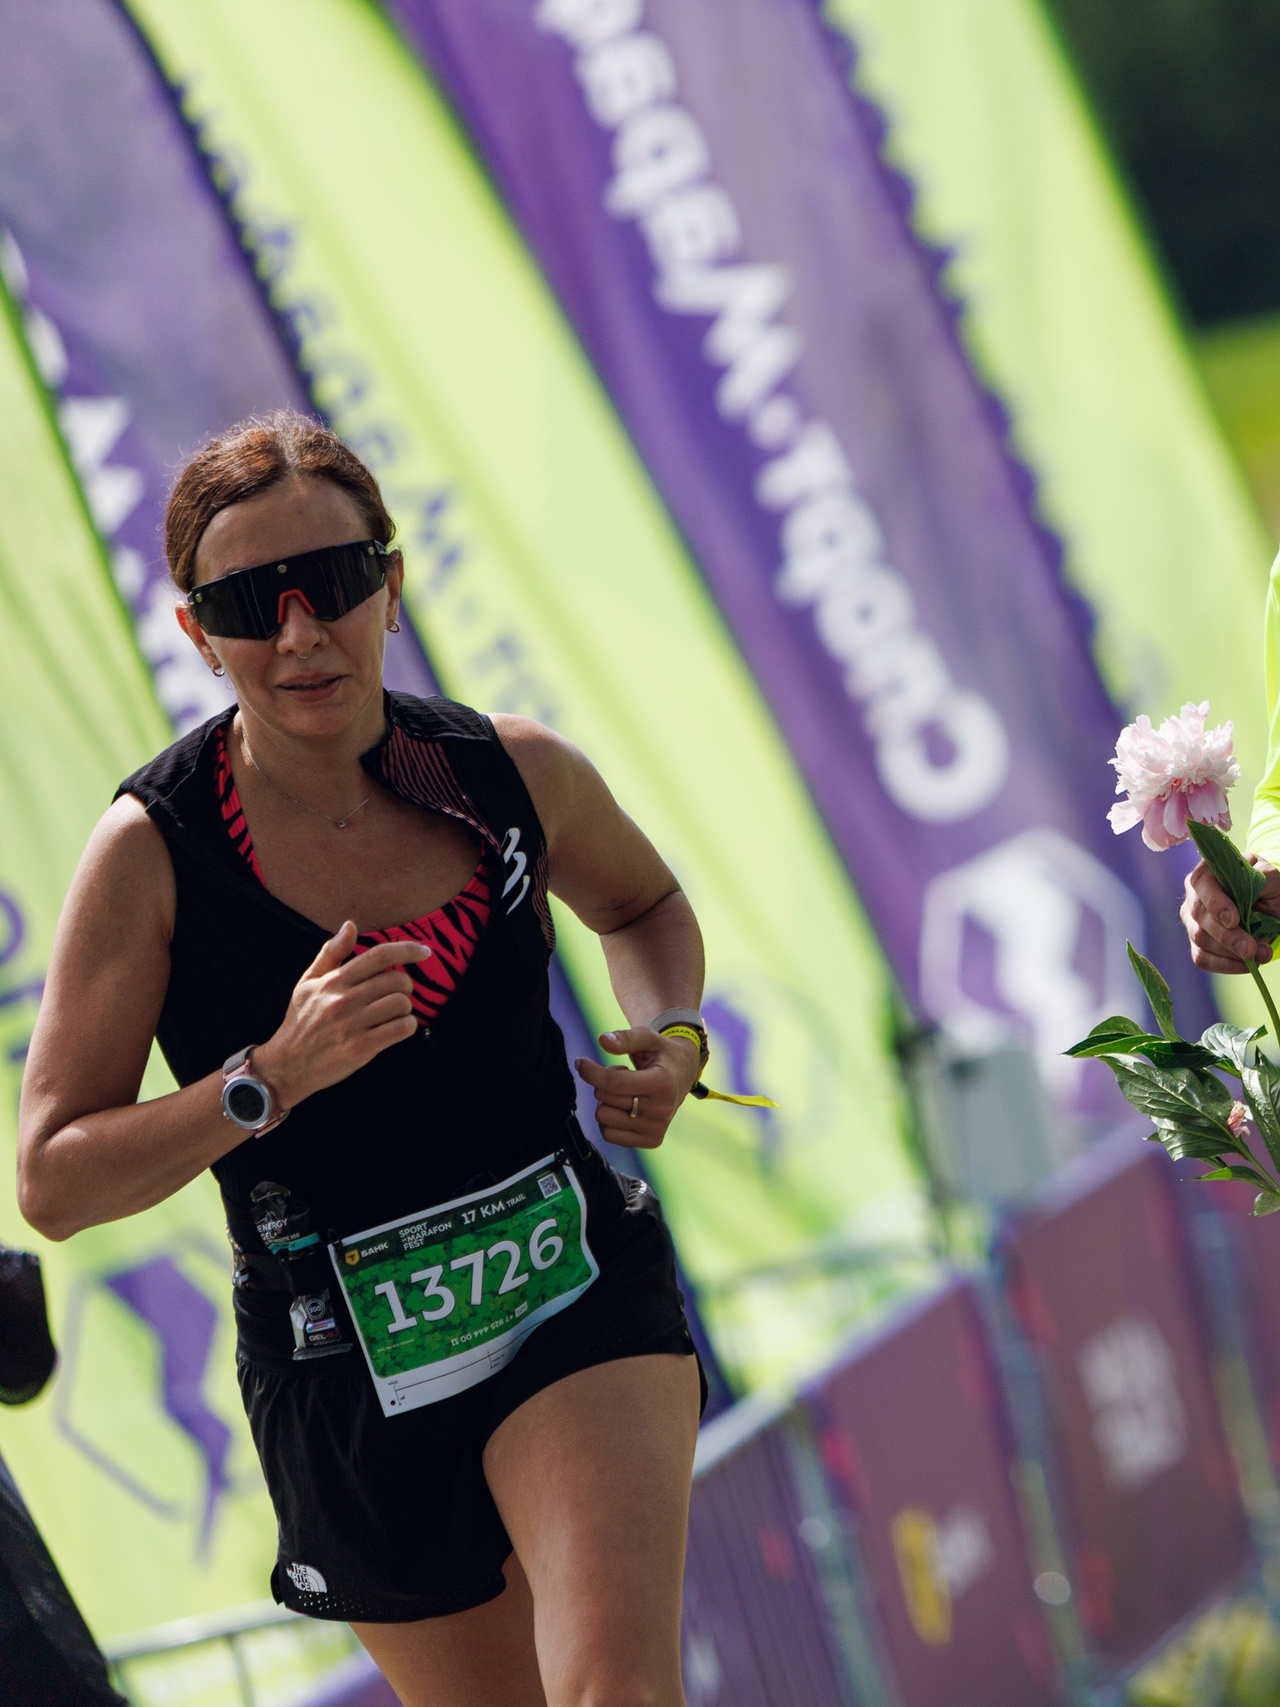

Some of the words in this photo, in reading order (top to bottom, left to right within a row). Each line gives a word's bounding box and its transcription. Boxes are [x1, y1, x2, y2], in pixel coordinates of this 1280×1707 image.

[461, 1210, 476, 1225] 17
[480, 1200, 505, 1218] KM
[506, 1193, 526, 1208] TRAIL
[256, 1218, 288, 1233] ENERGY
[399, 1222, 428, 1238] SPORT
[361, 1241, 389, 1258] БАНК
[403, 1238, 424, 1251] FEST
[374, 1218, 564, 1334] 13726
[490, 1319, 504, 1330] 925
[460, 1333, 472, 1343] 00
[474, 1327, 489, 1337] 444
[451, 1338, 459, 1346] 11
[291, 1563, 307, 1573] THE
